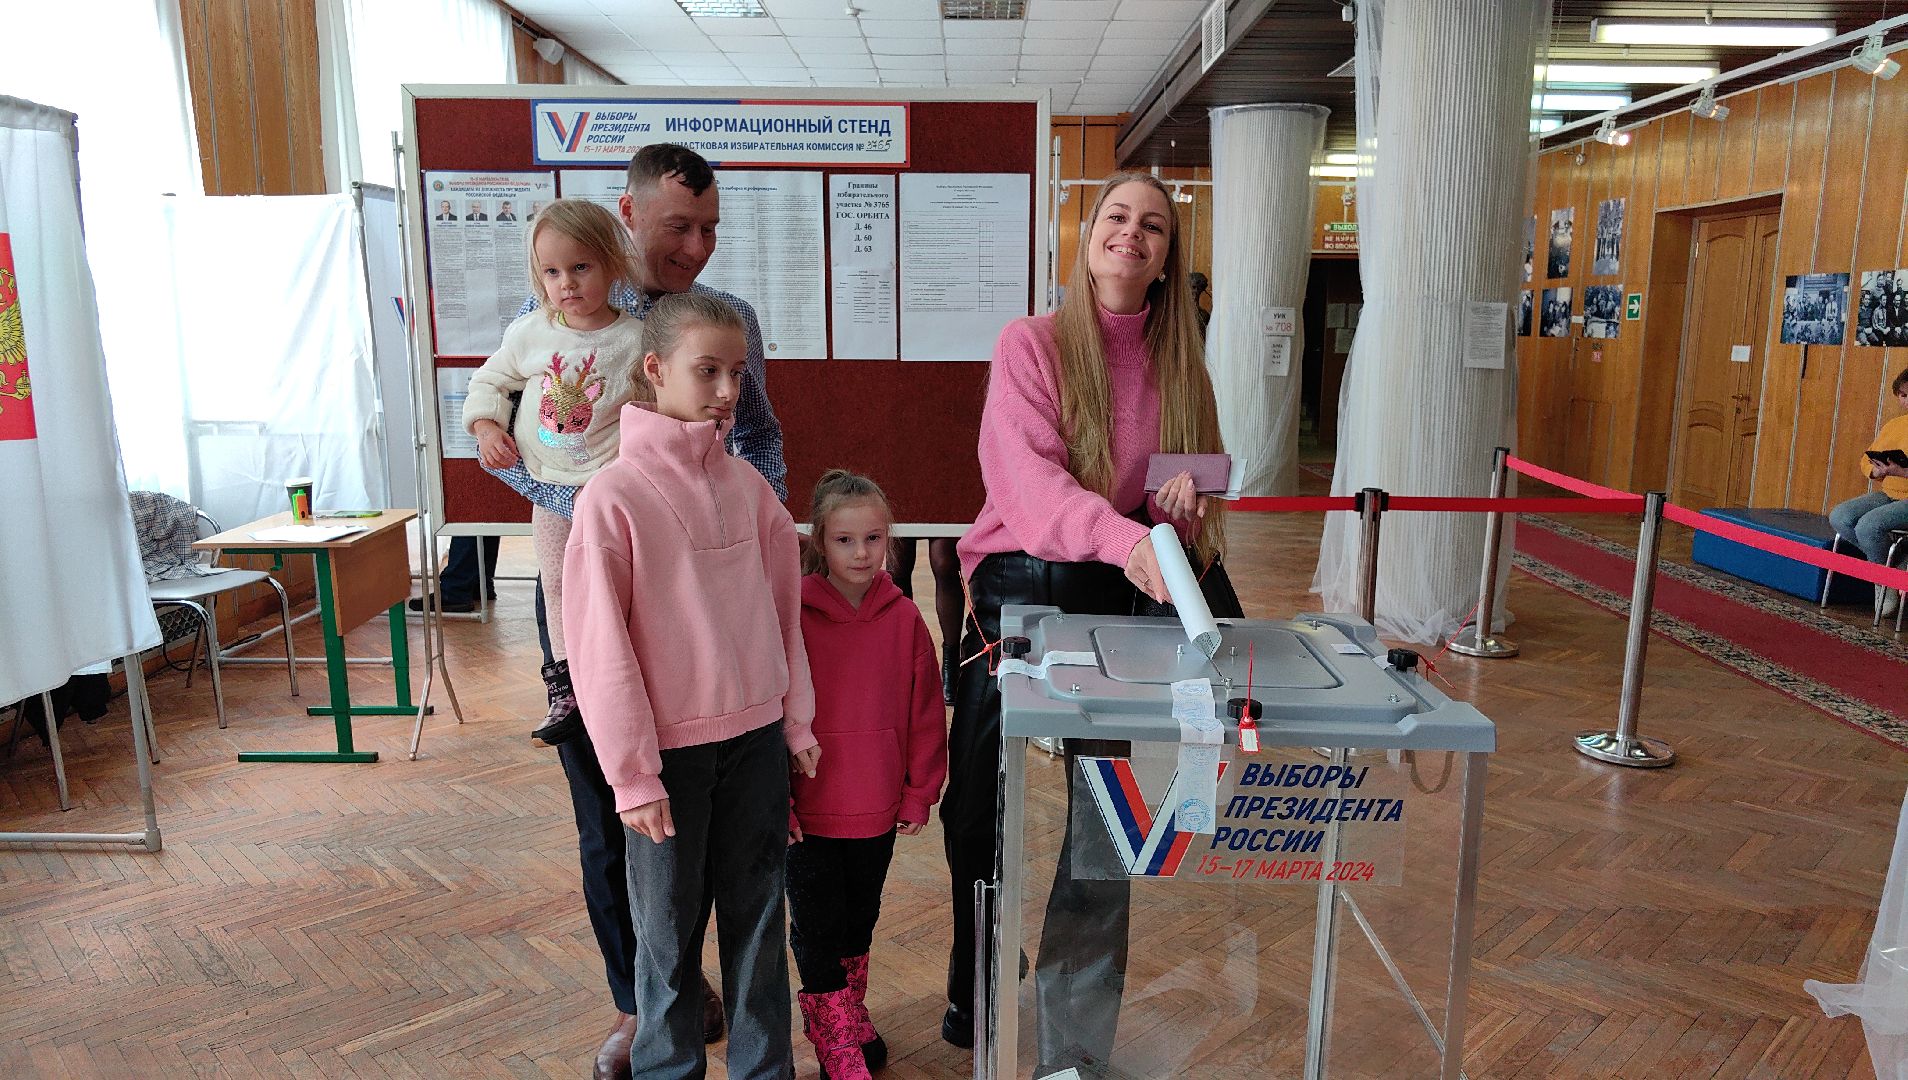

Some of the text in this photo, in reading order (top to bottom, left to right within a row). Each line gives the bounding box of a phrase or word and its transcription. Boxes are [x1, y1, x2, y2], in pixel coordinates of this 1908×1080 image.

[594, 111, 638, 121] ВЫБОРЫ
[590, 123, 651, 134] ПРЕЗИДЕНТА
[665, 116, 892, 137] ИНФОРМАЦИОННЫЙ СТЕНД
[586, 134, 626, 144] РОССИИ
[602, 145, 626, 154] МАРТА
[730, 141, 805, 151] ИЗБИРАТЕЛЬНАЯ
[806, 142, 854, 152] КОМИССИЯ
[847, 181, 878, 190] Границы
[837, 191, 889, 199] избирательного
[873, 201, 890, 209] 3765
[836, 211, 890, 220] ГОС. ОРБИТА
[863, 223, 873, 231] 46
[863, 234, 873, 242] 60
[863, 245, 873, 253] 63
[1274, 322, 1292, 332] 708
[1239, 763, 1370, 789] ВЫБОРЫ
[1223, 795, 1404, 825] ПРЕЗИДЕНТА
[1209, 826, 1326, 853] РОССИИ
[1255, 858, 1324, 881] МАРТА
[1325, 861, 1375, 882] 2024
